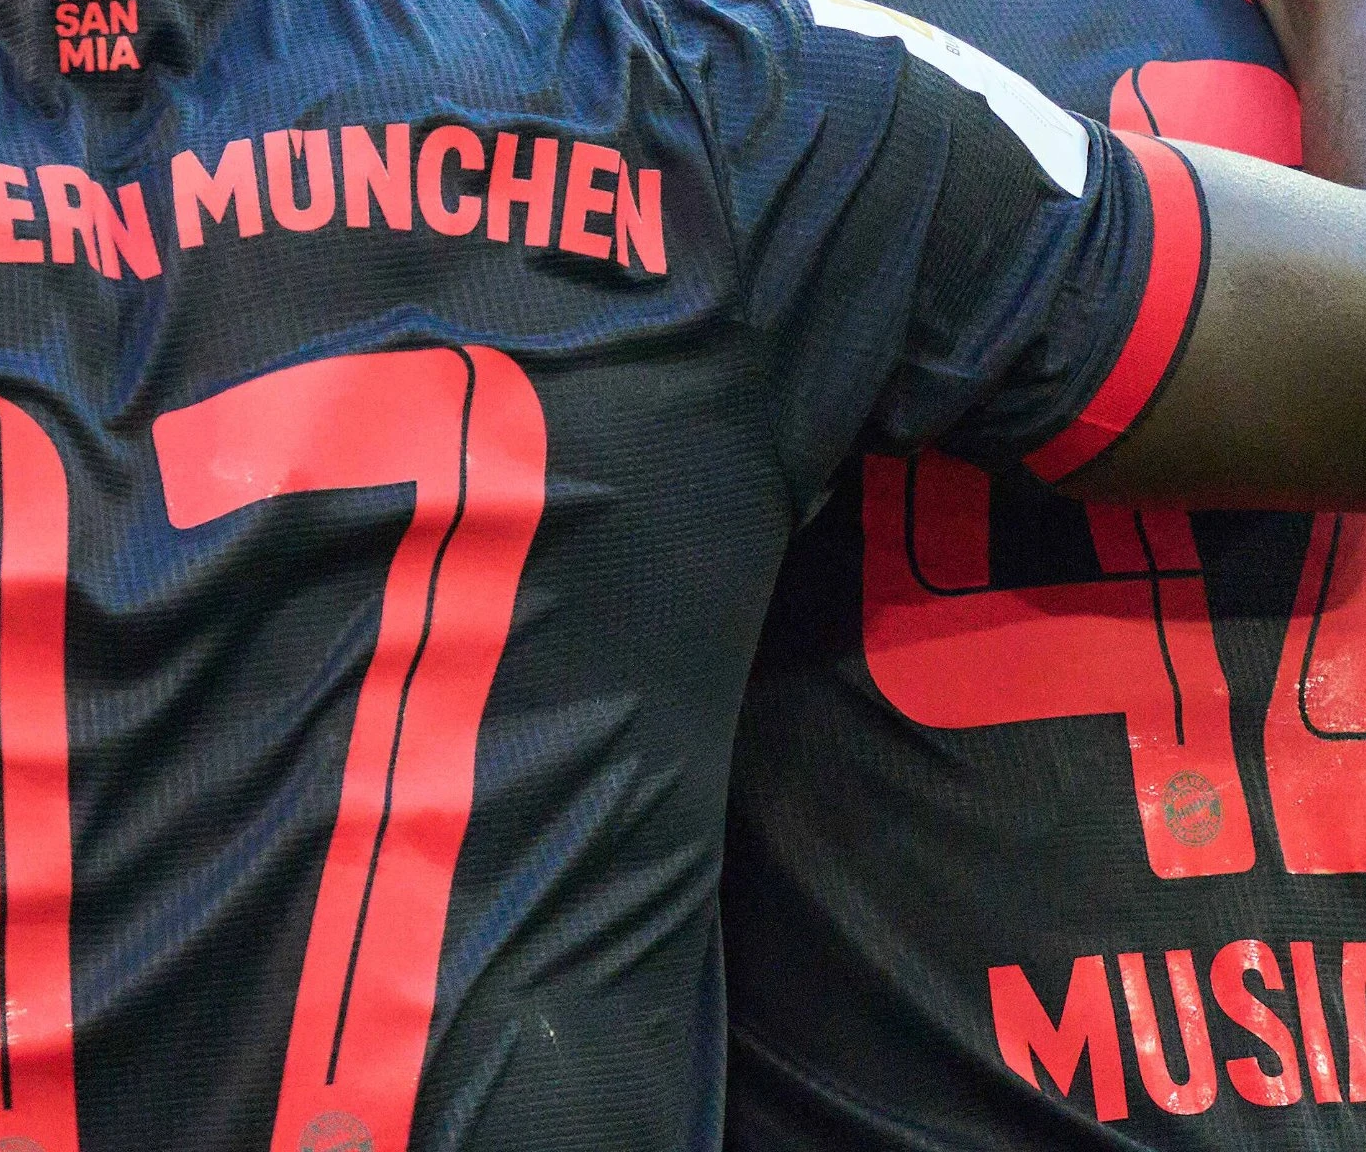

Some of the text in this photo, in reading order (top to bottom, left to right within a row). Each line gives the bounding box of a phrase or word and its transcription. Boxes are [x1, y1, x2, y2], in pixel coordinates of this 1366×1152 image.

[55, 0, 139, 38] SAN
[58, 35, 141, 74] MIA
[170, 122, 668, 276] MÜNCHEN
